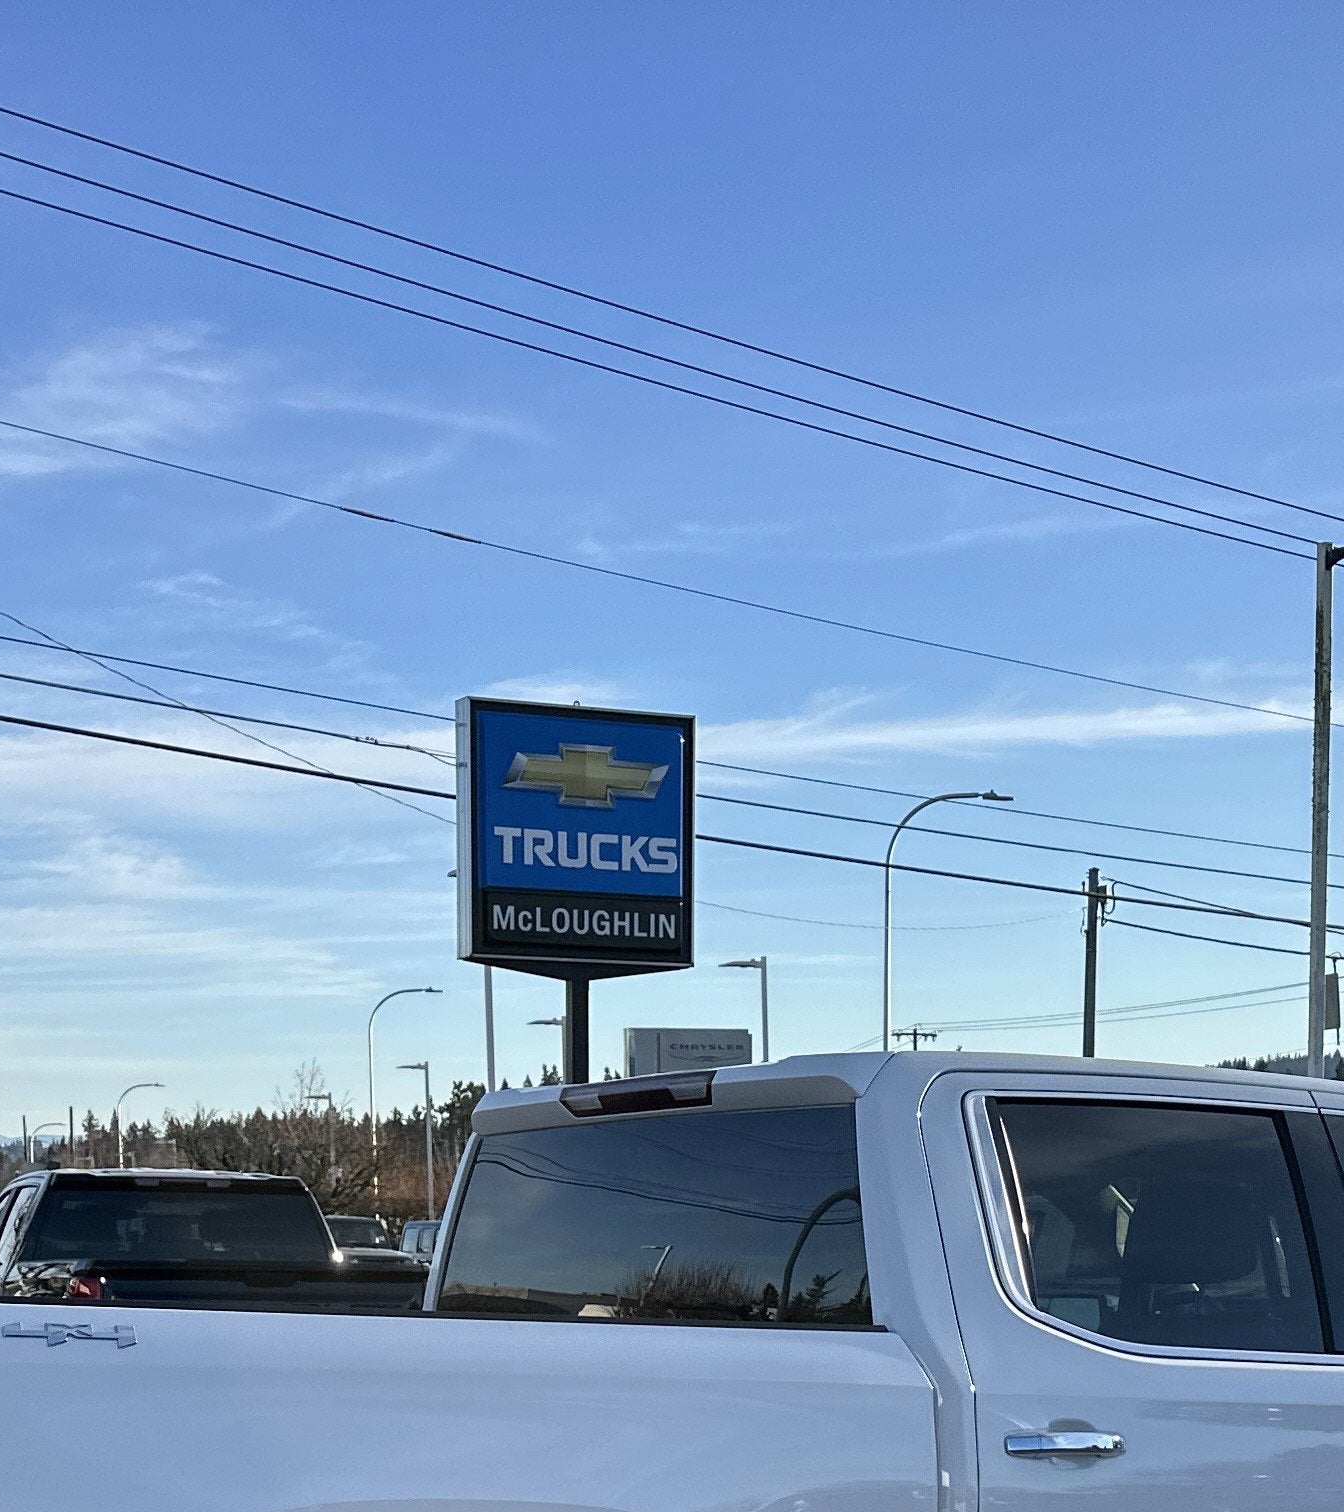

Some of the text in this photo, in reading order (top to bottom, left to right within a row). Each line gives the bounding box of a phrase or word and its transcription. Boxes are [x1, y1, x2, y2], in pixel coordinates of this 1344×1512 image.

[493, 826, 678, 874] TRUCKS
[492, 904, 676, 939] McLOUGHLIN
[669, 1043, 745, 1051] CHRYSLER
